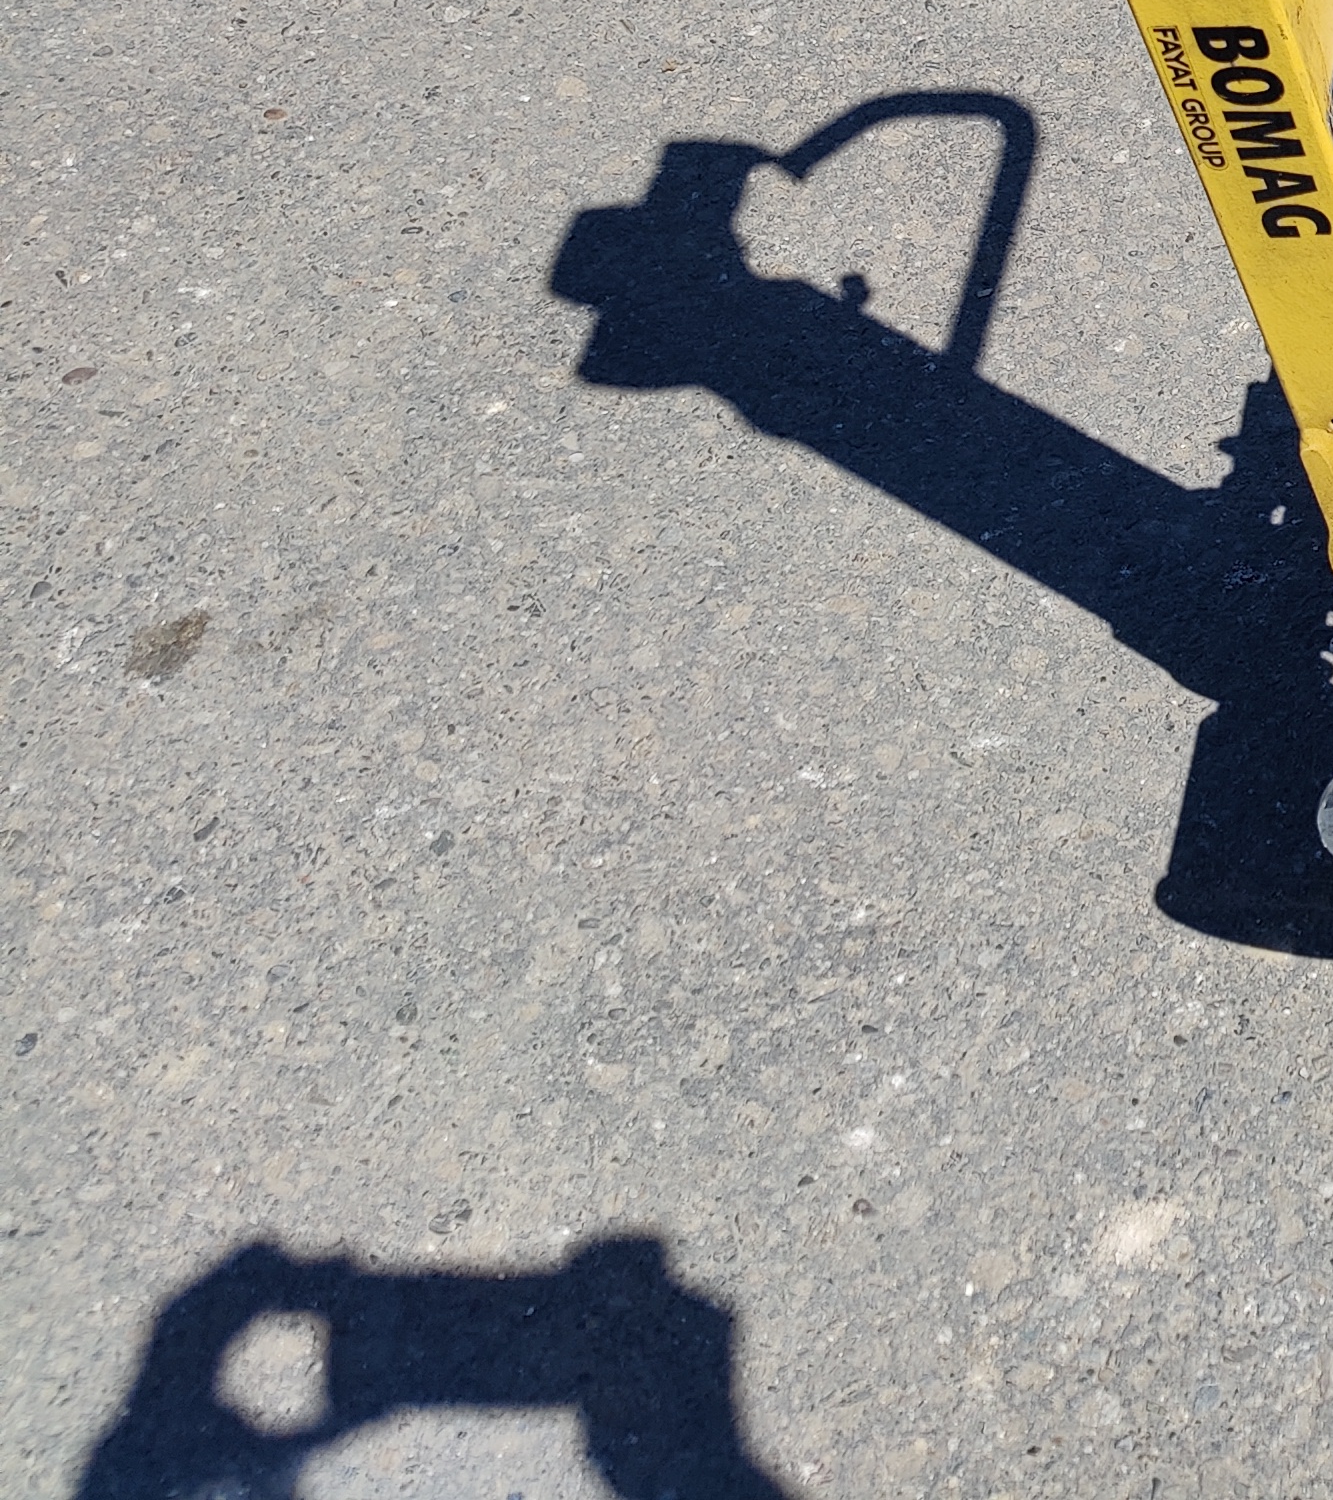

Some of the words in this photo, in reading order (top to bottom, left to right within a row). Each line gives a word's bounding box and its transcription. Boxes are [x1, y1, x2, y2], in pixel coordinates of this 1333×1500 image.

[1153, 27, 1198, 92] FAYAT
[1181, 98, 1227, 169] GROUP
[1191, 26, 1332, 238] BOMAG
